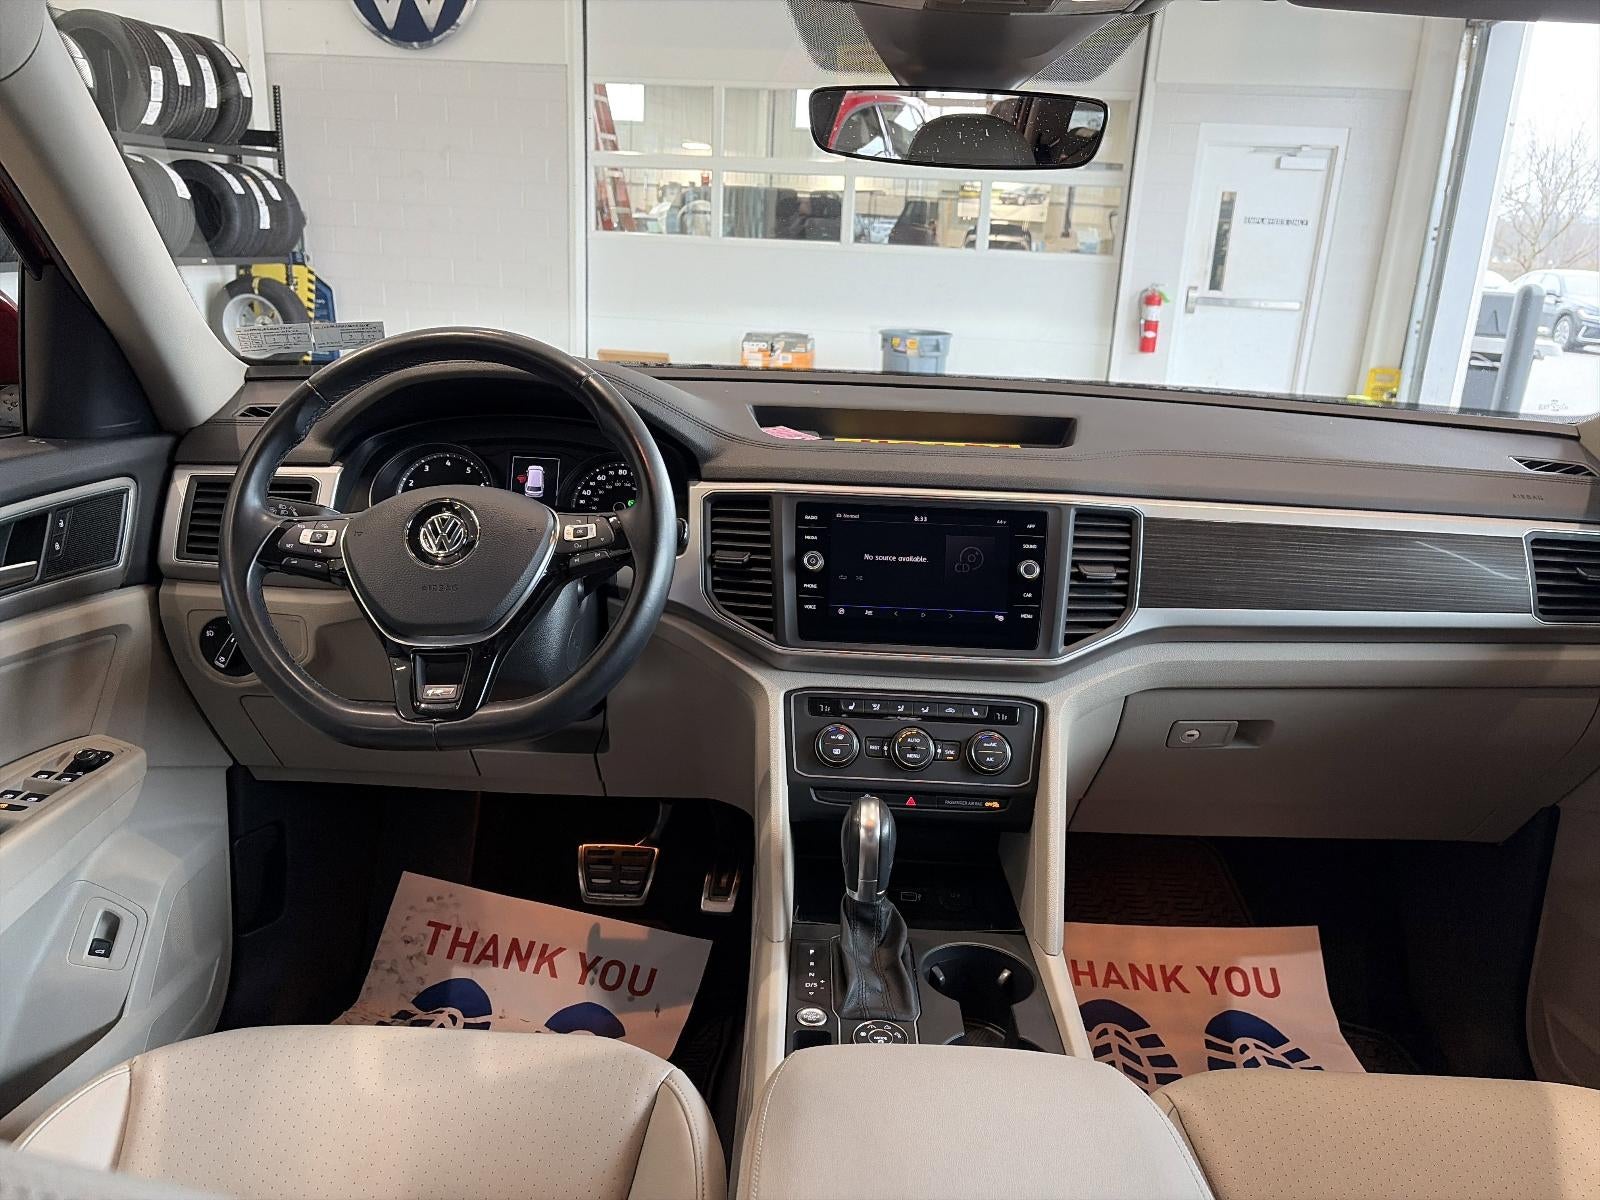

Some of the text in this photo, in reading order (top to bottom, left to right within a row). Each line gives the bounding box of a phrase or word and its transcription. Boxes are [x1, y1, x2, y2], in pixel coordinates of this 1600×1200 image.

[426, 920, 658, 997] THANK YOU
[1070, 959, 1282, 998] HANK YOU
